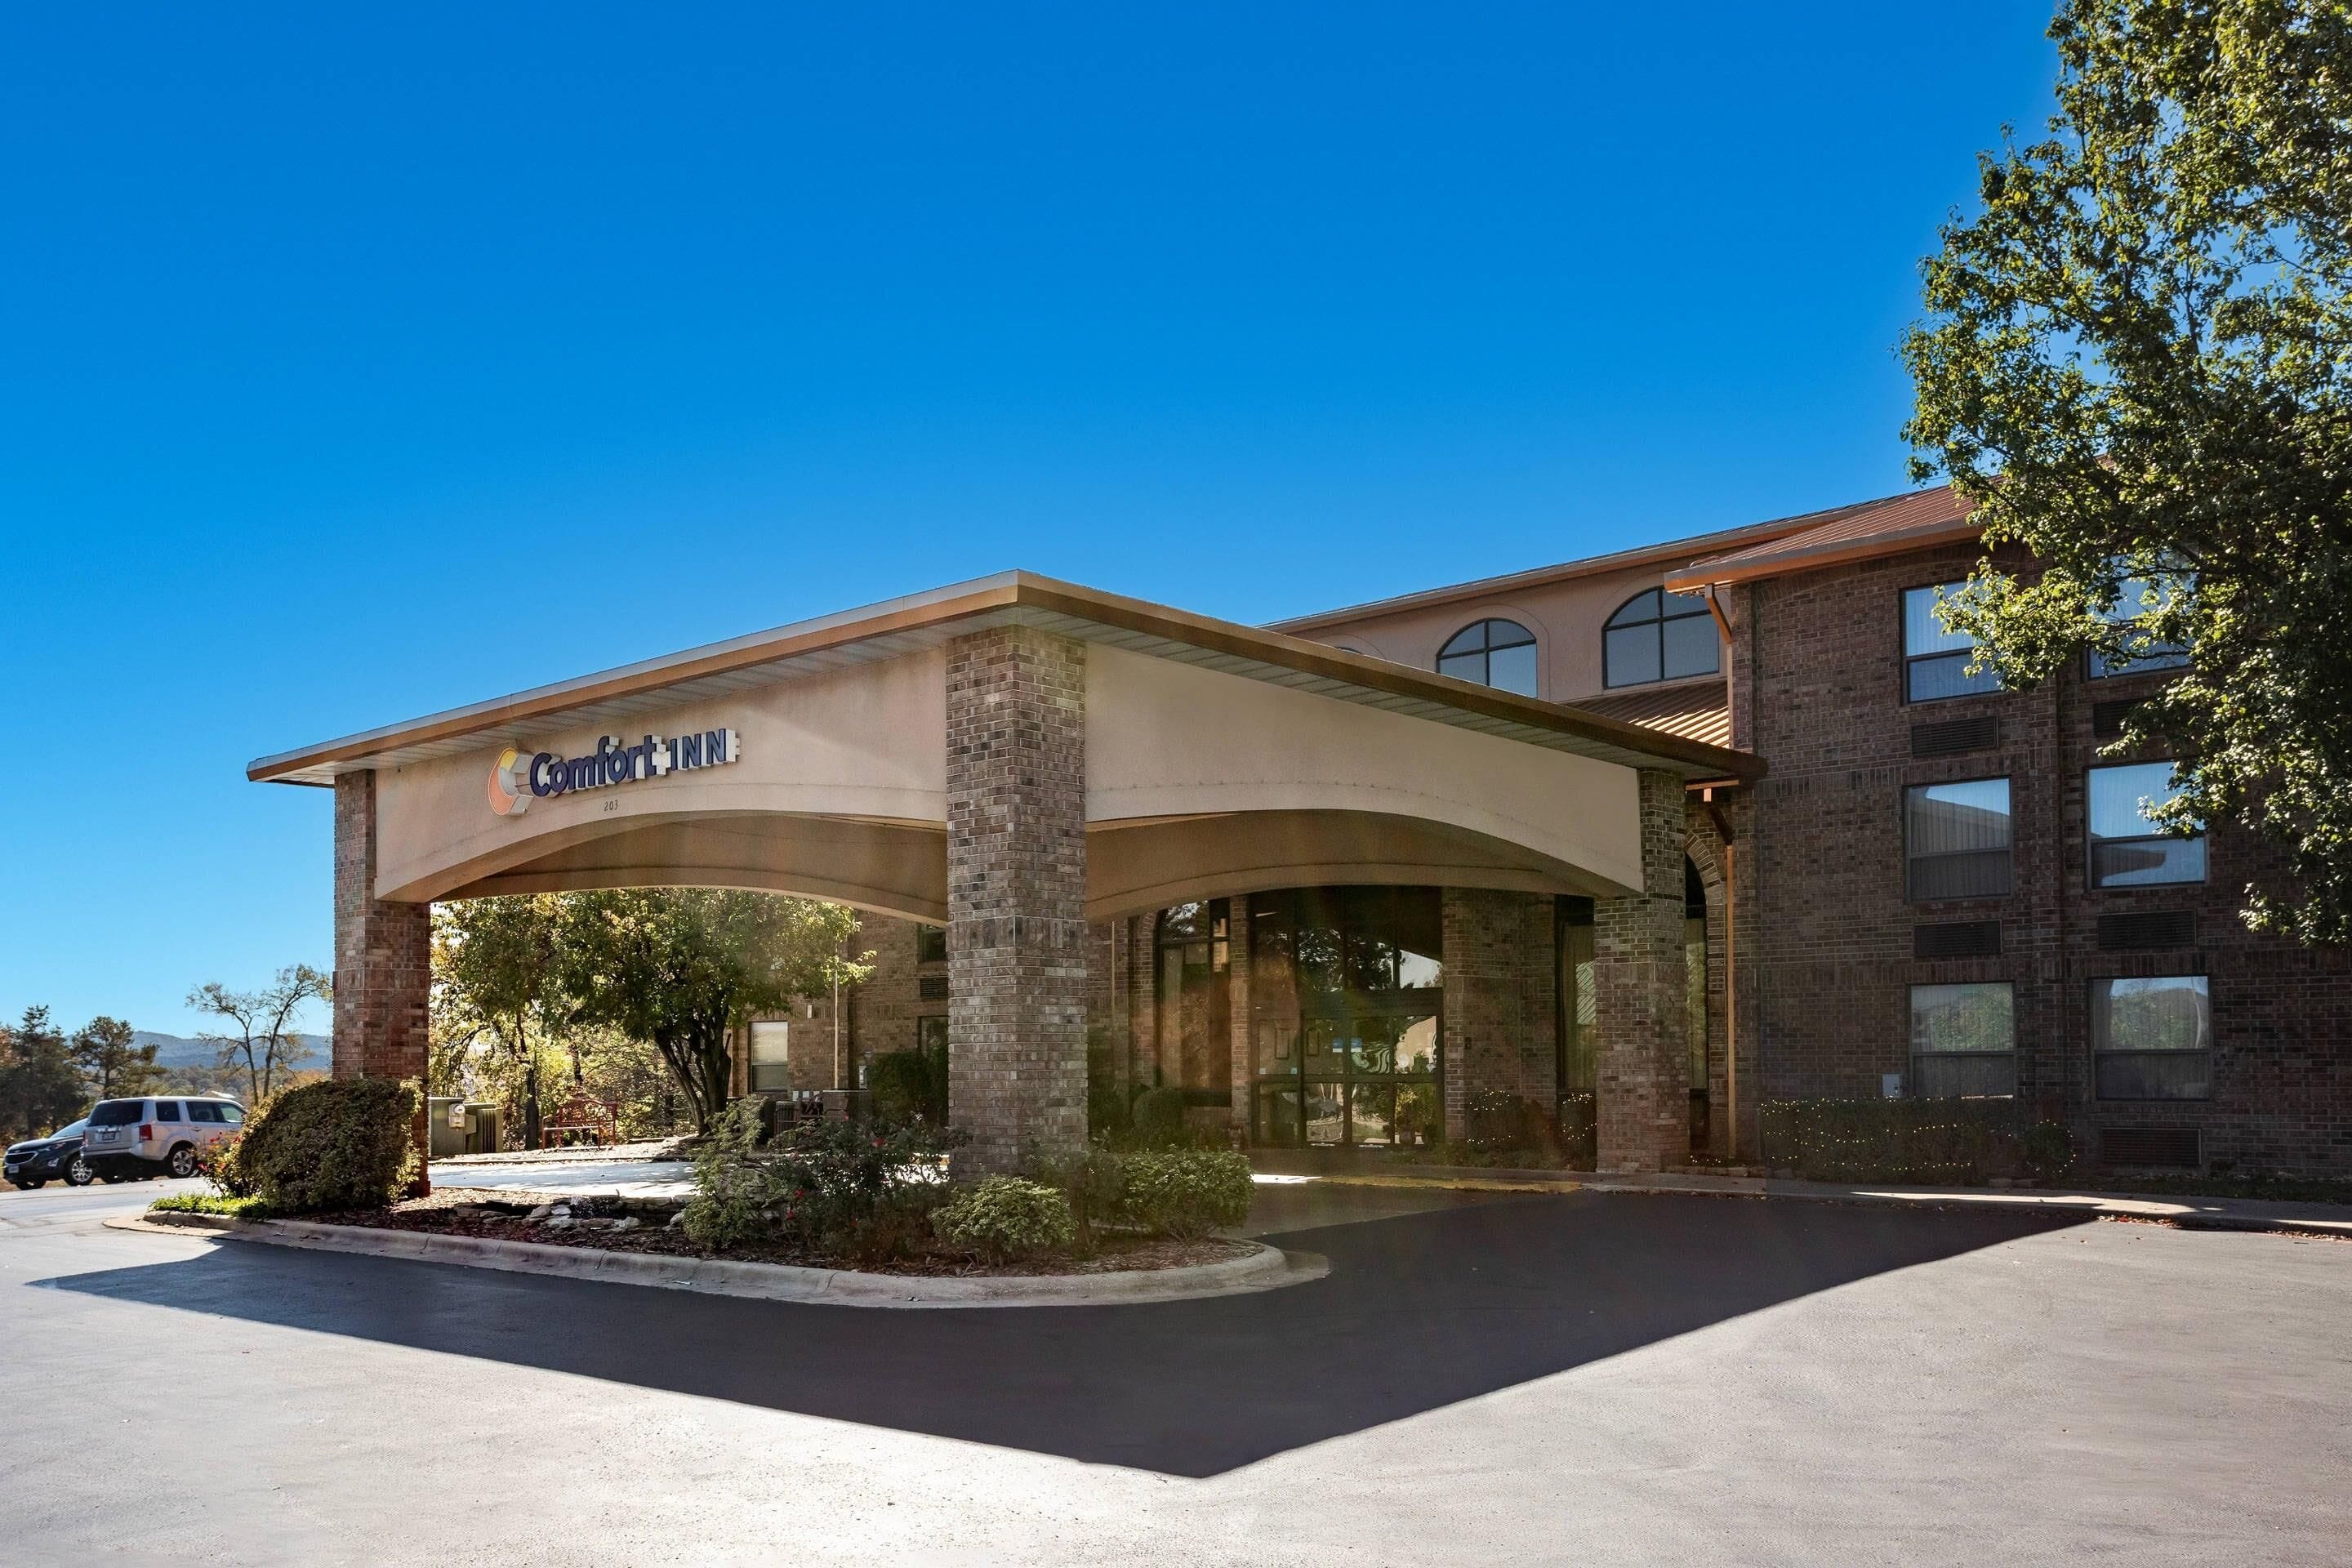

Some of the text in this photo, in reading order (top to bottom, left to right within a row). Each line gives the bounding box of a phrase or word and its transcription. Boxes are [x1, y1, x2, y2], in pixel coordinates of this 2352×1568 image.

[529, 728, 728, 797] Comfort INN
[604, 800, 619, 812] 203
